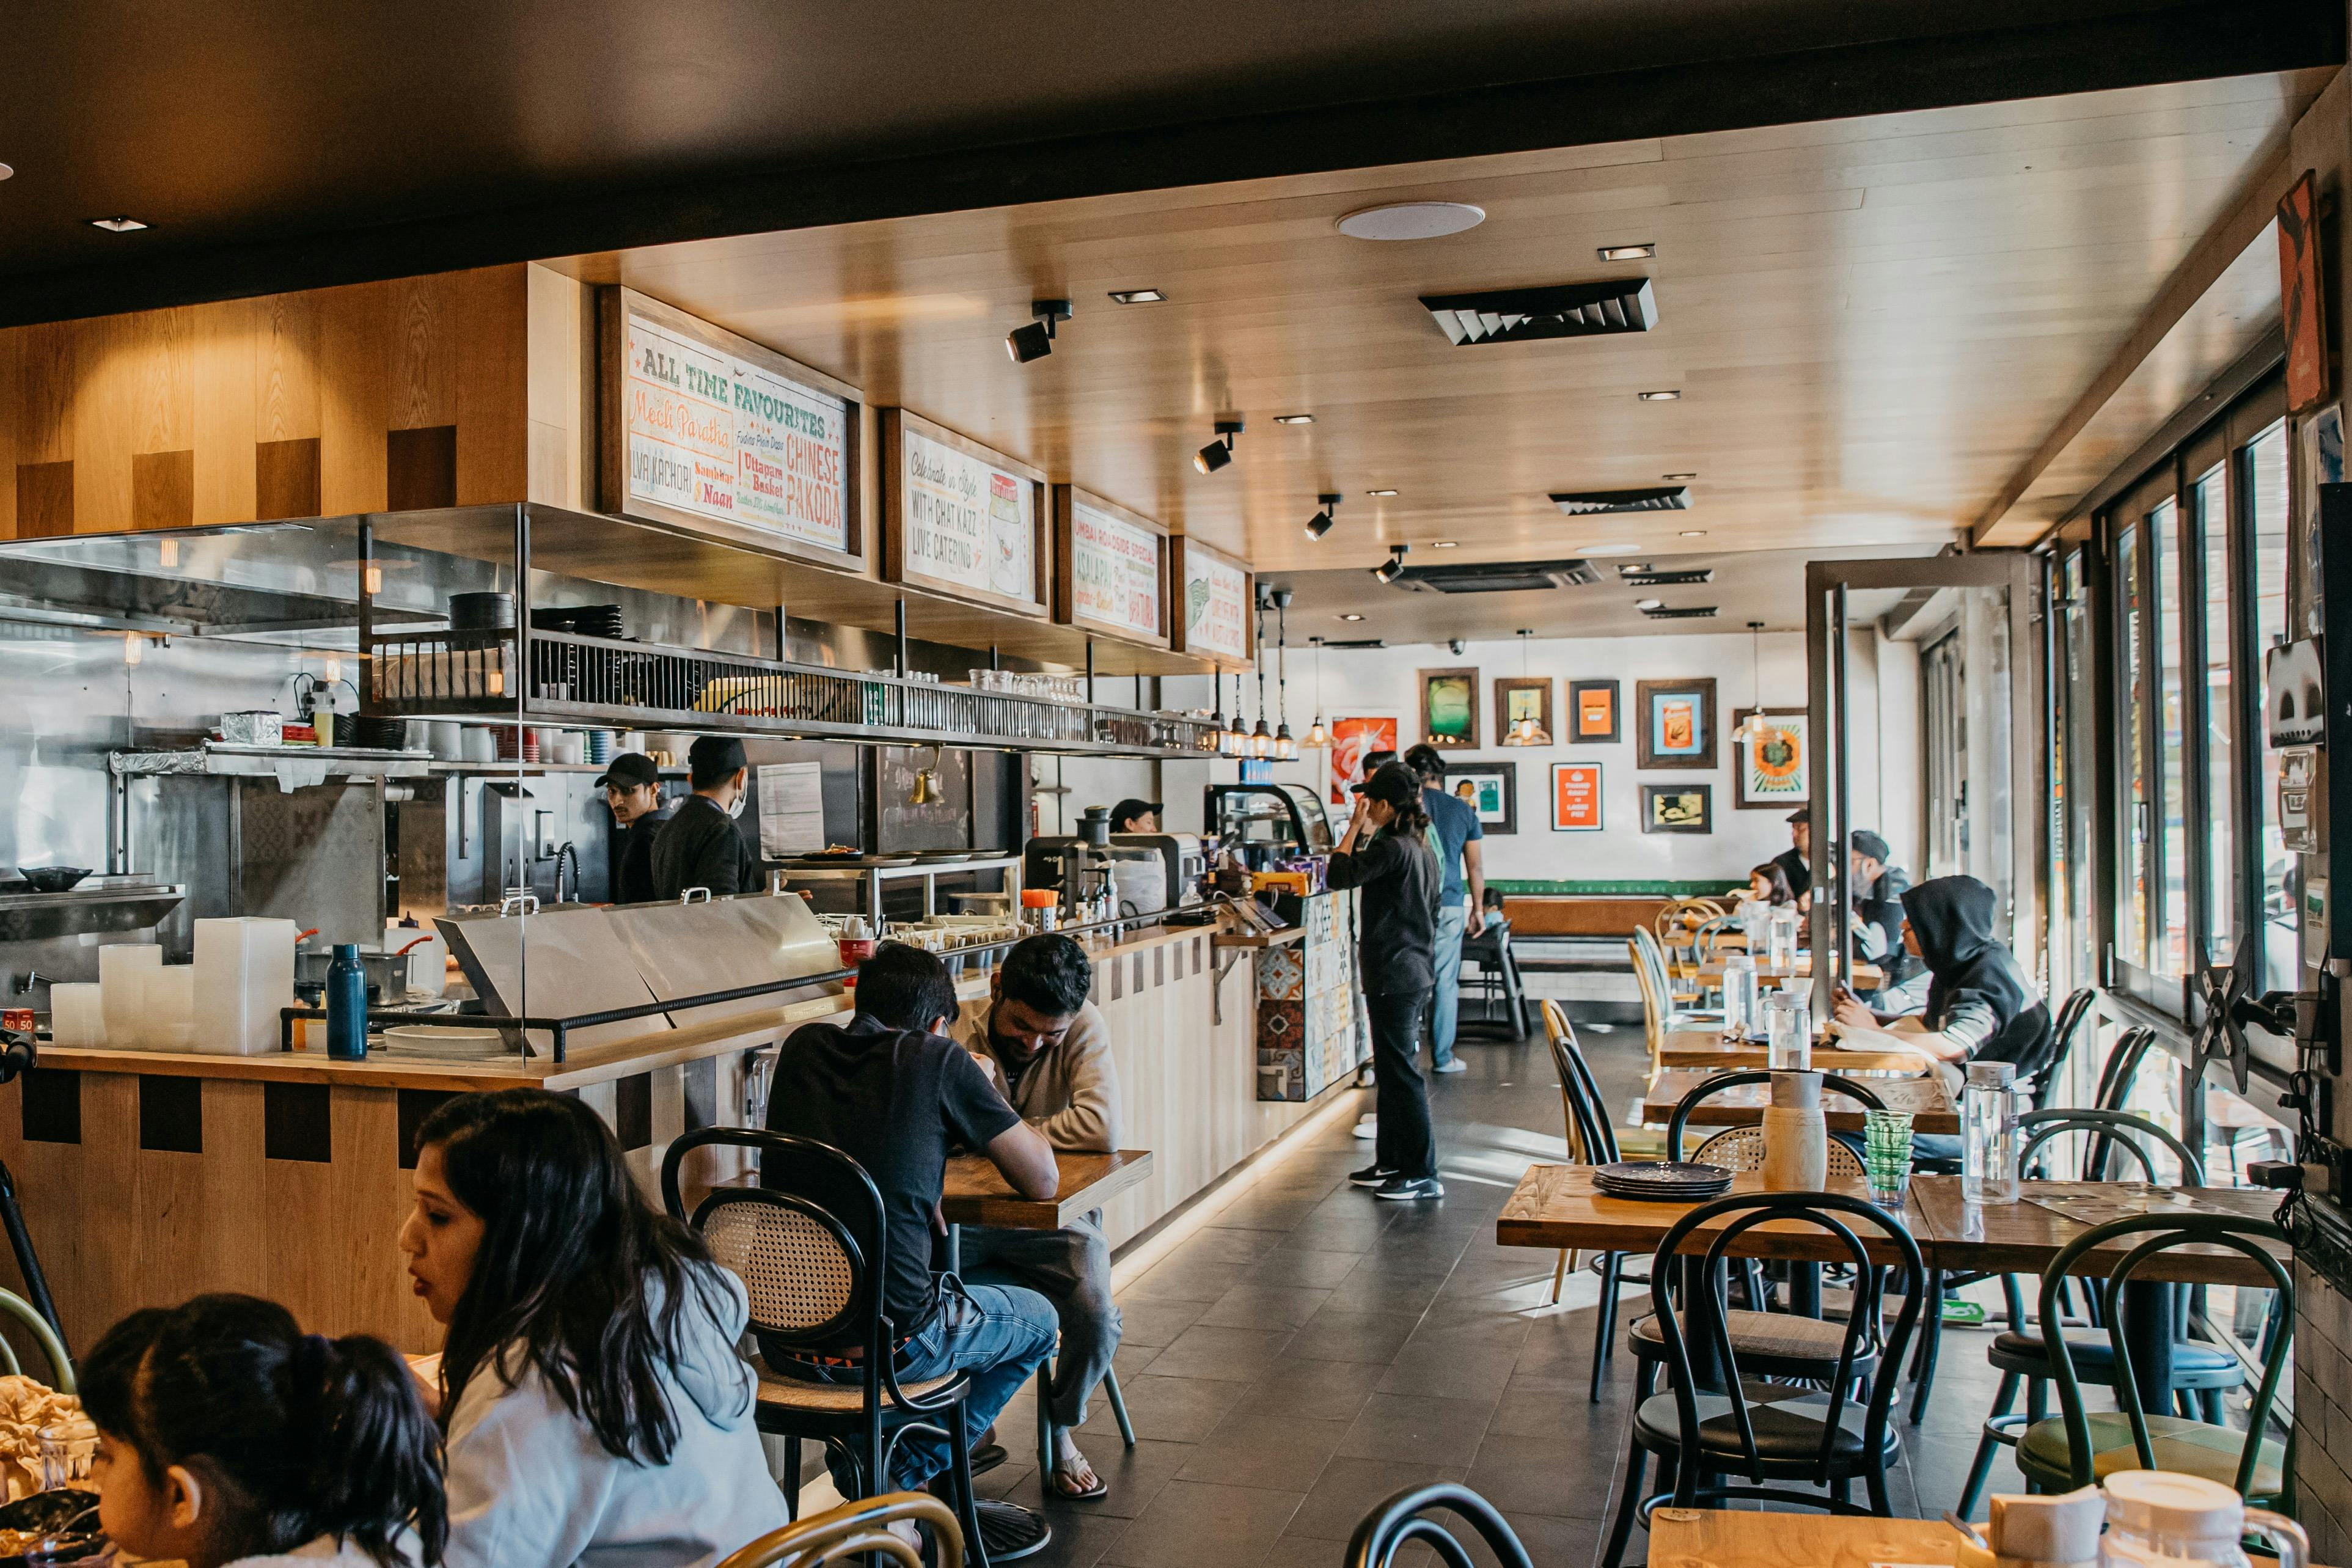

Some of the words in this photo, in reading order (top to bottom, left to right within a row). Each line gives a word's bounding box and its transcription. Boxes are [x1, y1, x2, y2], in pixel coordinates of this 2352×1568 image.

[643, 348, 680, 386] ALL
[686, 364, 728, 405] TIME
[734, 383, 825, 439] FAVOURITES
[630, 389, 673, 429] Mooli
[676, 404, 730, 449] Paratha
[757, 434, 769, 449] Plain
[786, 433, 840, 486] CHINESE
[630, 450, 649, 482] LVA
[653, 456, 692, 493] KACHORI
[695, 461, 734, 484] Sambhar
[744, 452, 783, 480] Uttapam
[753, 474, 783, 498] Basket
[911, 452, 947, 485] Celebrate
[948, 469, 956, 489] in
[959, 469, 978, 502] Style
[703, 483, 733, 509] Naan
[786, 474, 841, 529] PAKODA
[912, 489, 933, 523] WITH
[936, 498, 954, 530] CHAT
[957, 505, 976, 537] KAZZ
[913, 526, 931, 558] LIVE
[934, 533, 971, 569] CATERING
[1132, 543, 1155, 565] SPECIAL
[20, 1020, 32, 1030] 50
